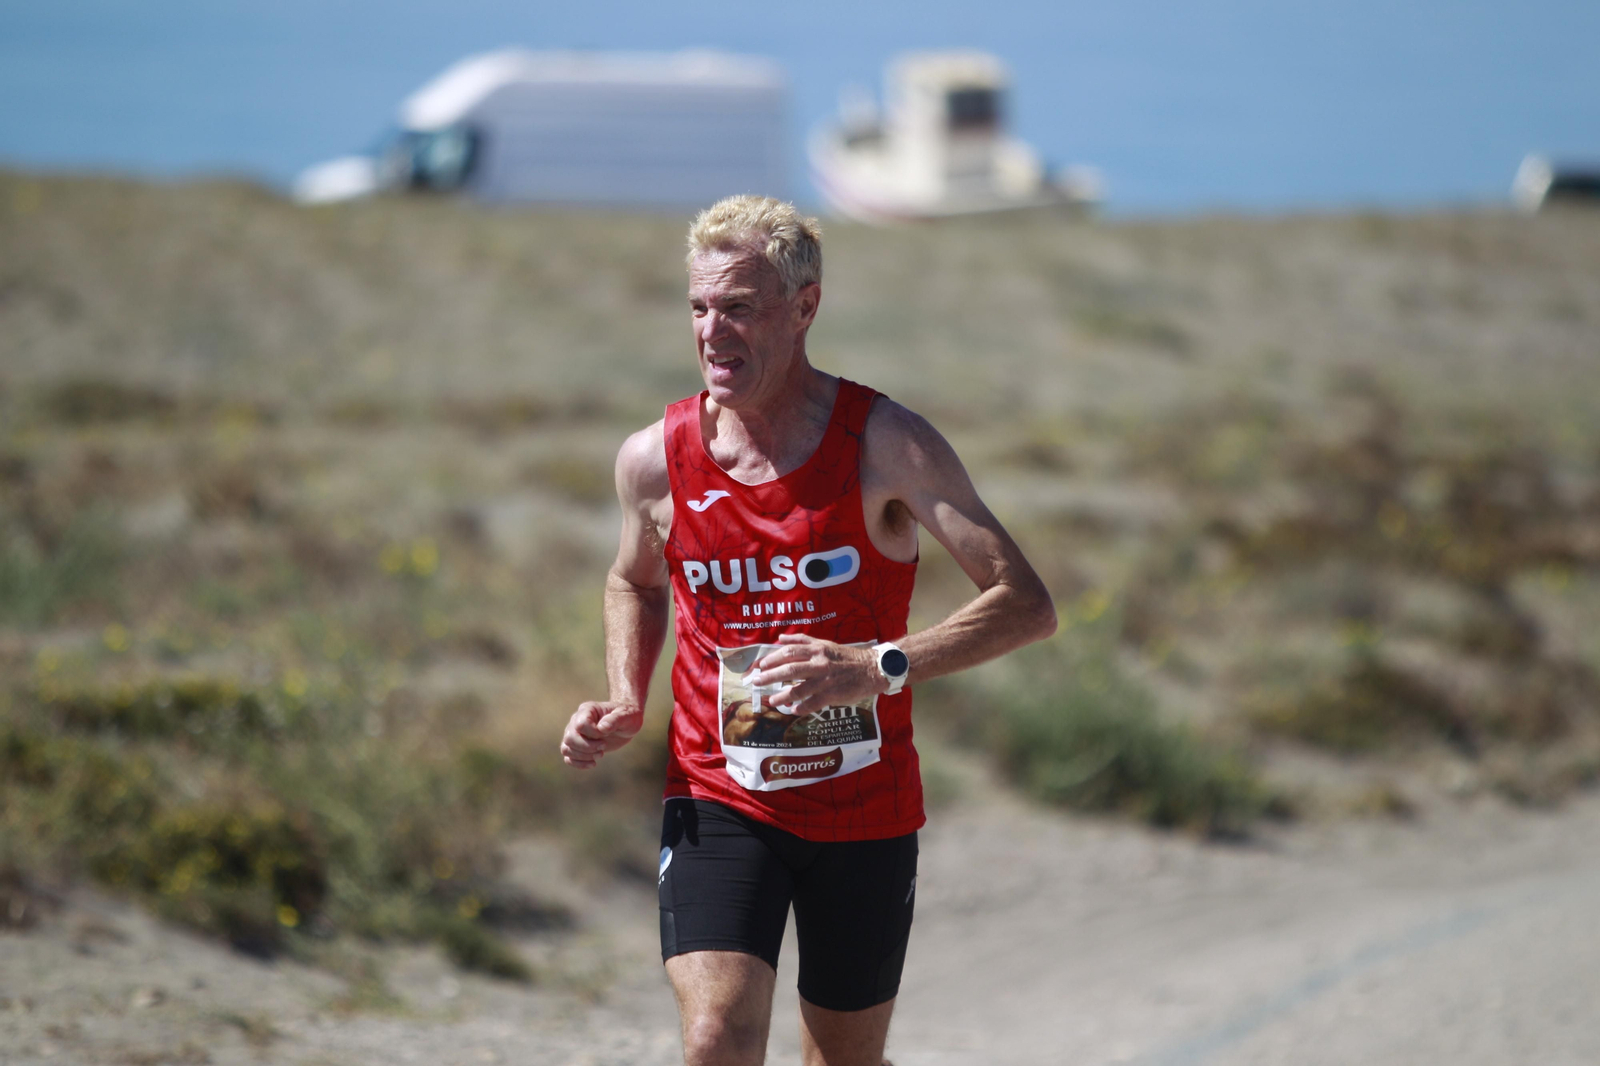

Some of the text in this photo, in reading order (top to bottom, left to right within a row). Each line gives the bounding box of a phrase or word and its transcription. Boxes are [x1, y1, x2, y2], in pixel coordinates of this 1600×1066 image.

[682, 545, 861, 594] PULSO
[742, 601, 815, 617] RUNNING
[723, 611, 837, 630] WWW.PULSOENTRENAMIENTO.COM
[808, 705, 859, 723] XIII
[808, 717, 860, 730] CARRERA
[808, 724, 860, 736] POPULAR
[820, 730, 863, 740] ESPARTANOS
